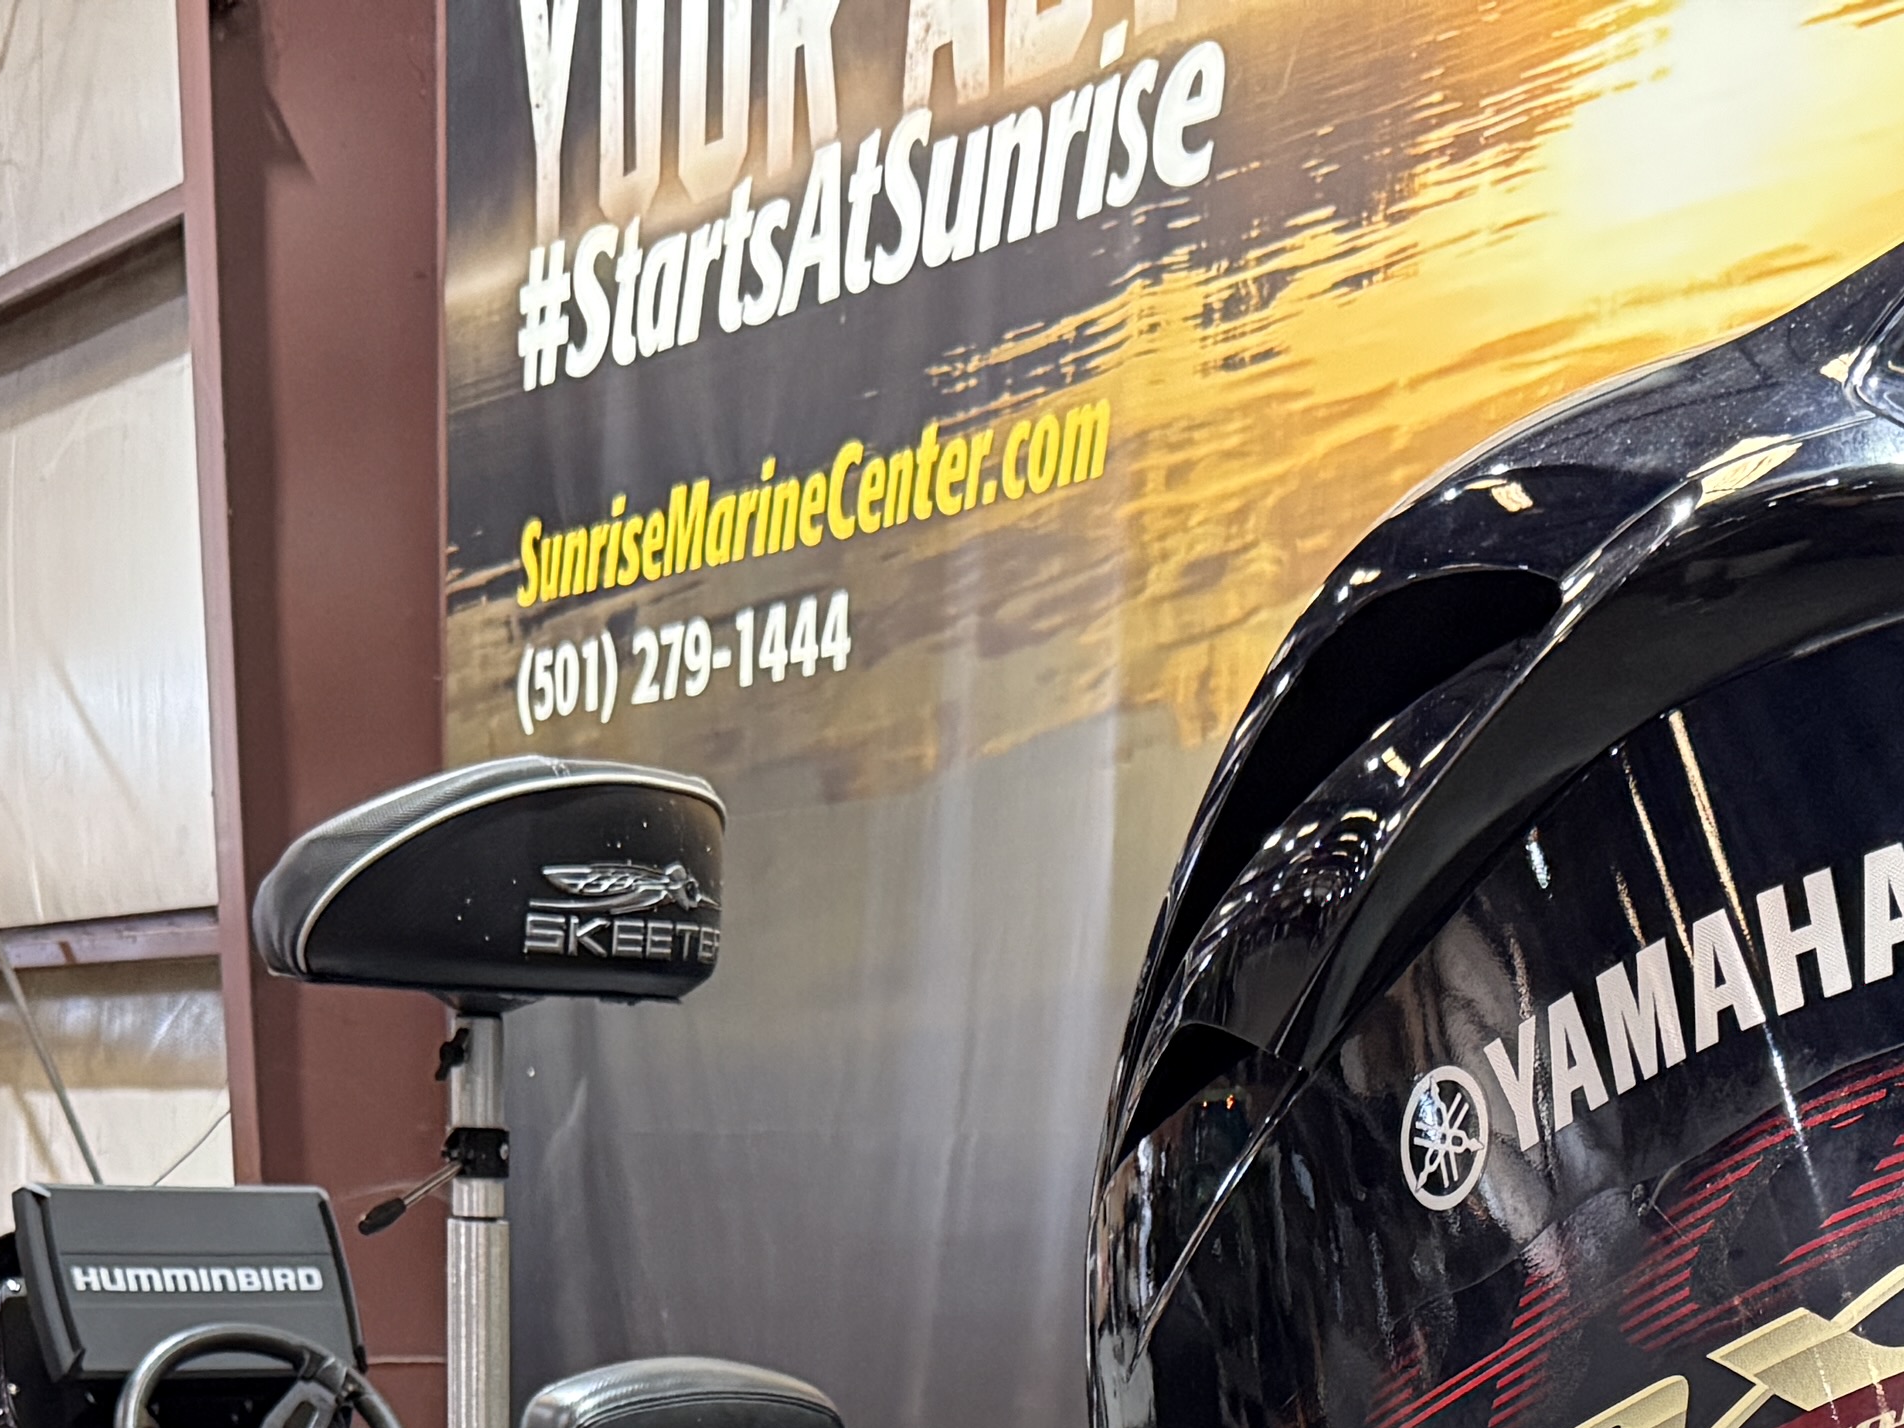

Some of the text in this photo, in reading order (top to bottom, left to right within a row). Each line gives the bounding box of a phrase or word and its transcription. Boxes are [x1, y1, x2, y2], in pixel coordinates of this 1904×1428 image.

[517, 20, 1227, 391] #StartsAtSunrise
[517, 398, 1112, 608] SunriseMarineCenter.com
[517, 589, 852, 735] (501) 279-1444
[70, 1264, 324, 1293] HUMMINBIRD
